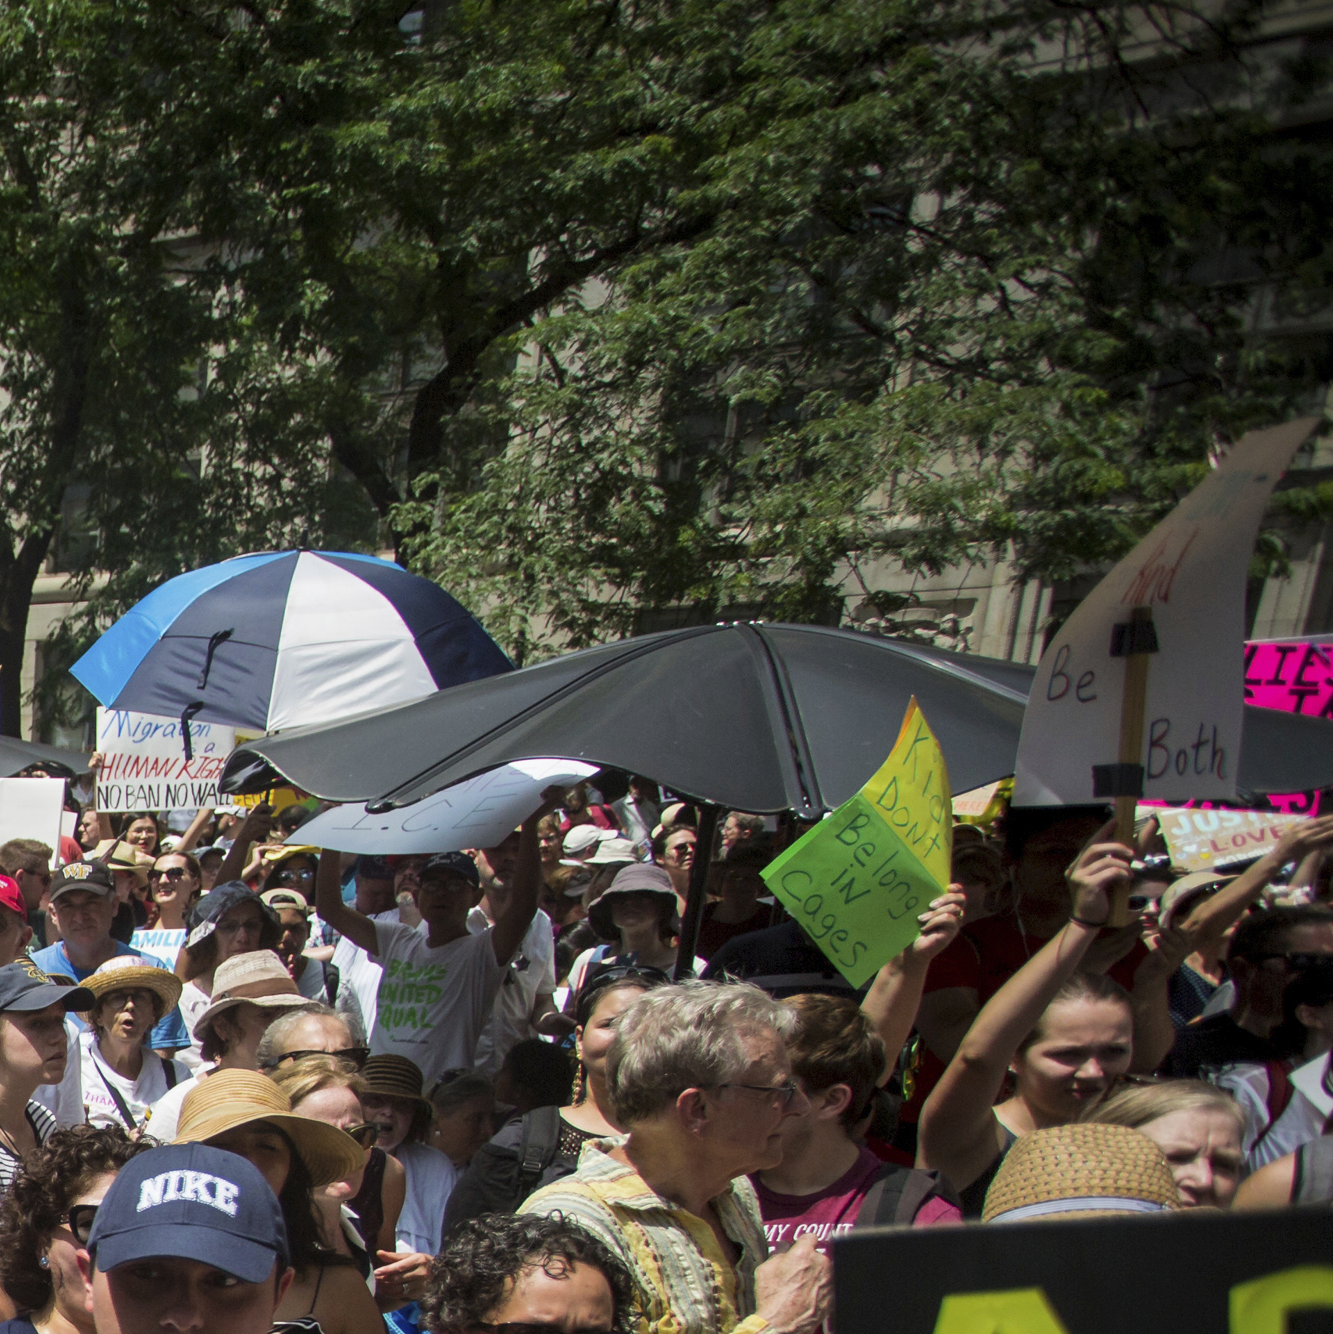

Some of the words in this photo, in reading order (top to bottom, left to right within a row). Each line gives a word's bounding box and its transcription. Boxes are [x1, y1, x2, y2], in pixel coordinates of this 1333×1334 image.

[1046, 643, 1097, 703] Be
[99, 753, 176, 783] HUMAN
[1146, 718, 1226, 781] Both
[97, 785, 121, 809] NO
[126, 784, 159, 808] BAN
[165, 783, 187, 808] NO
[136, 1169, 239, 1218] NIKE
[763, 1223, 790, 1241] MY
